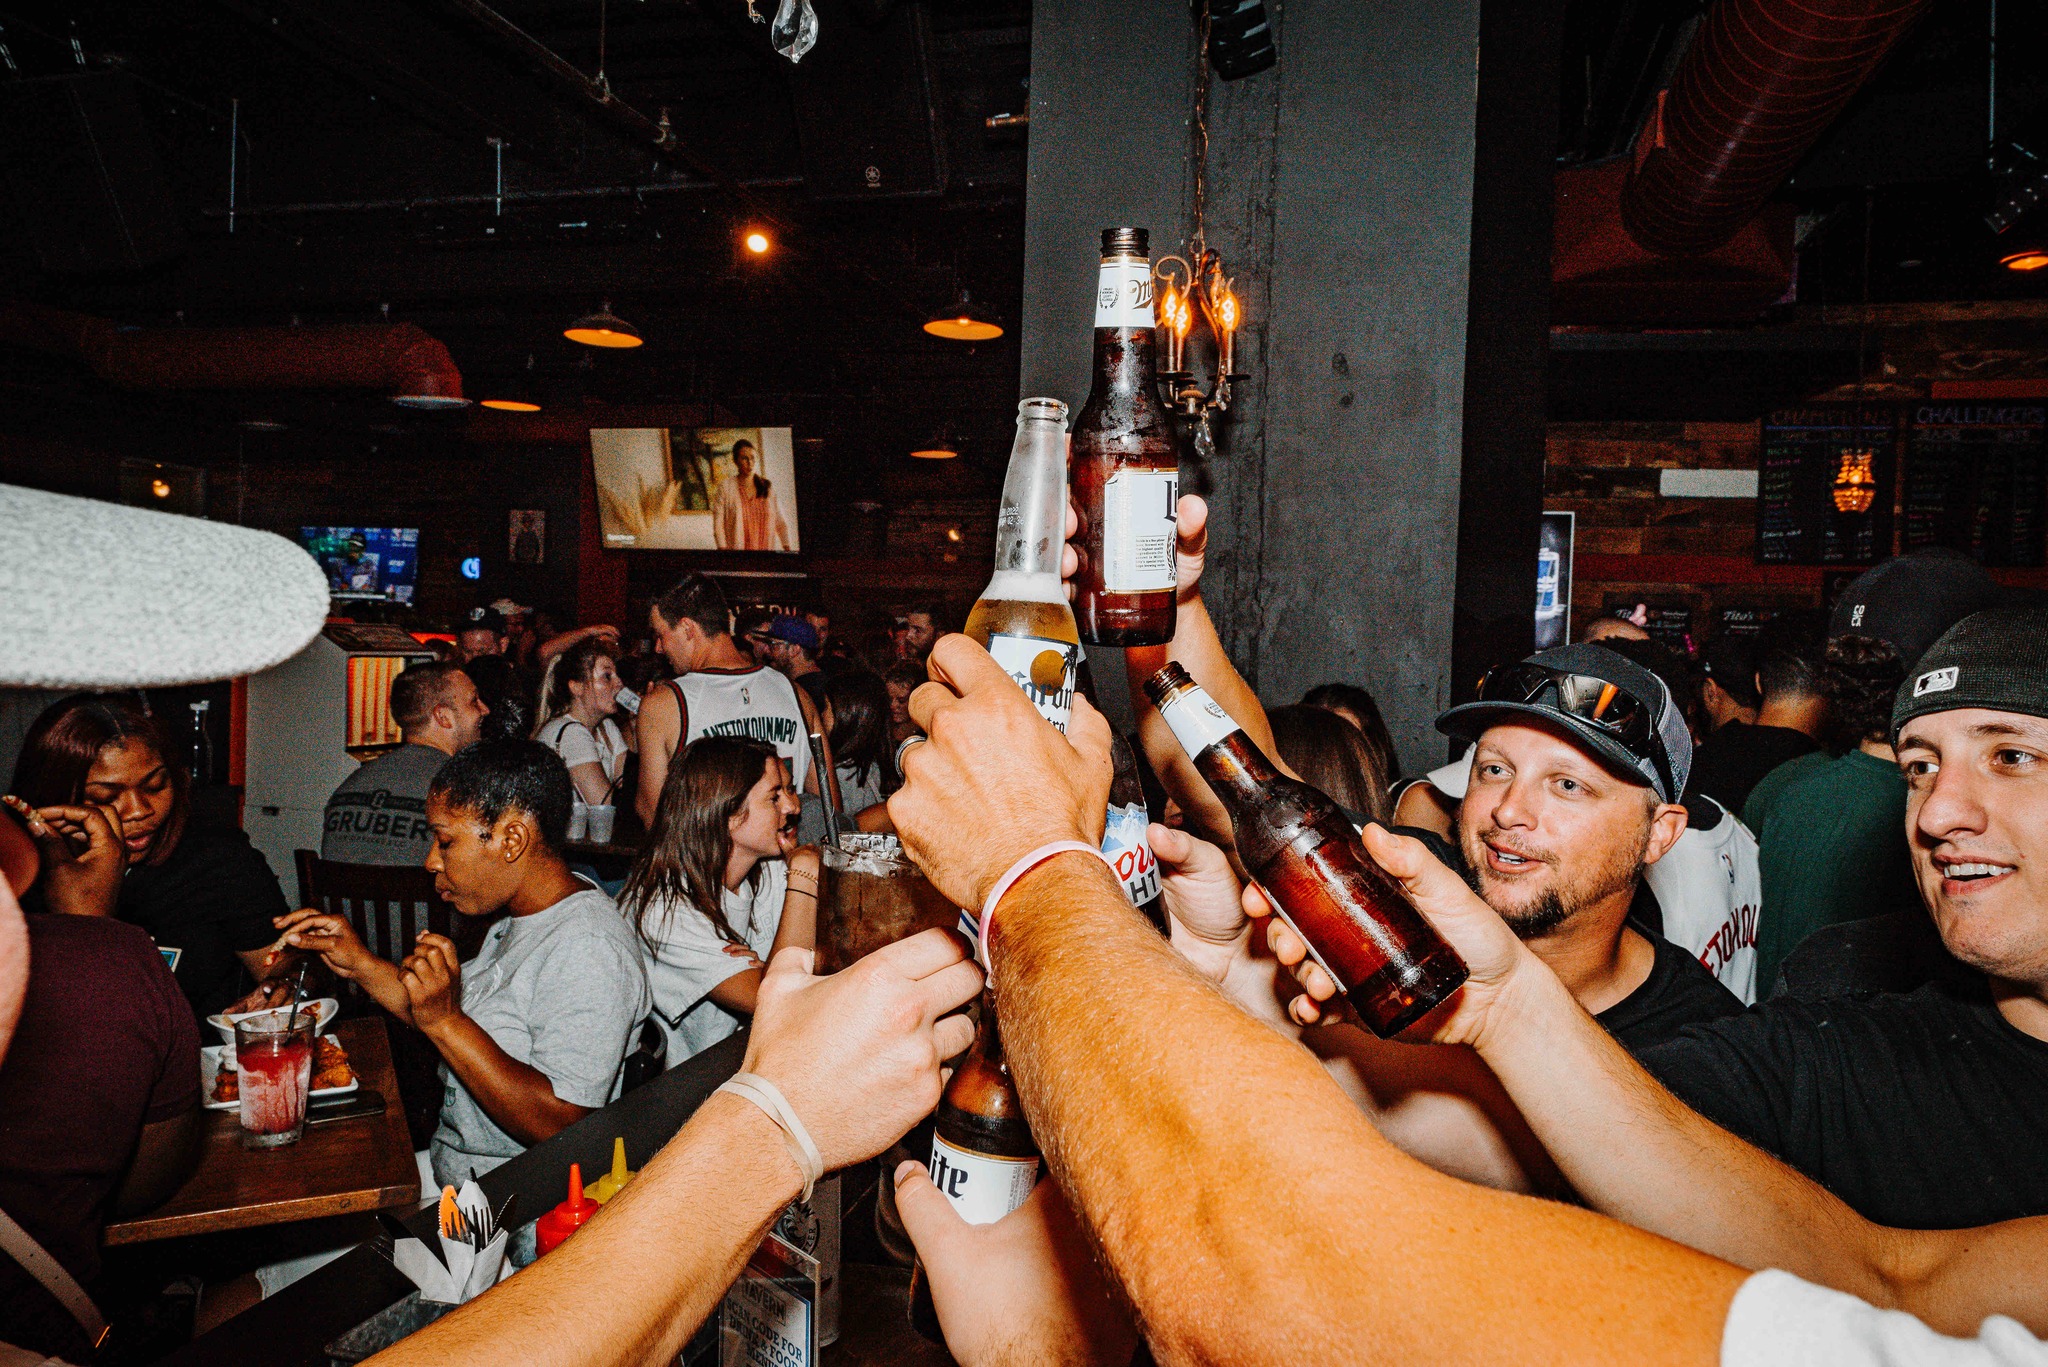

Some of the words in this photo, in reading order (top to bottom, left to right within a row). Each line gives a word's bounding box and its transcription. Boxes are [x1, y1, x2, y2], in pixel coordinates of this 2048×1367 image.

[1164, 480, 1177, 523] Li
[326, 811, 428, 840] GRUBER
[929, 1149, 969, 1199] ite
[726, 1297, 751, 1326] SCAN
[752, 1317, 780, 1347] CODE
[781, 1336, 803, 1363] FOR
